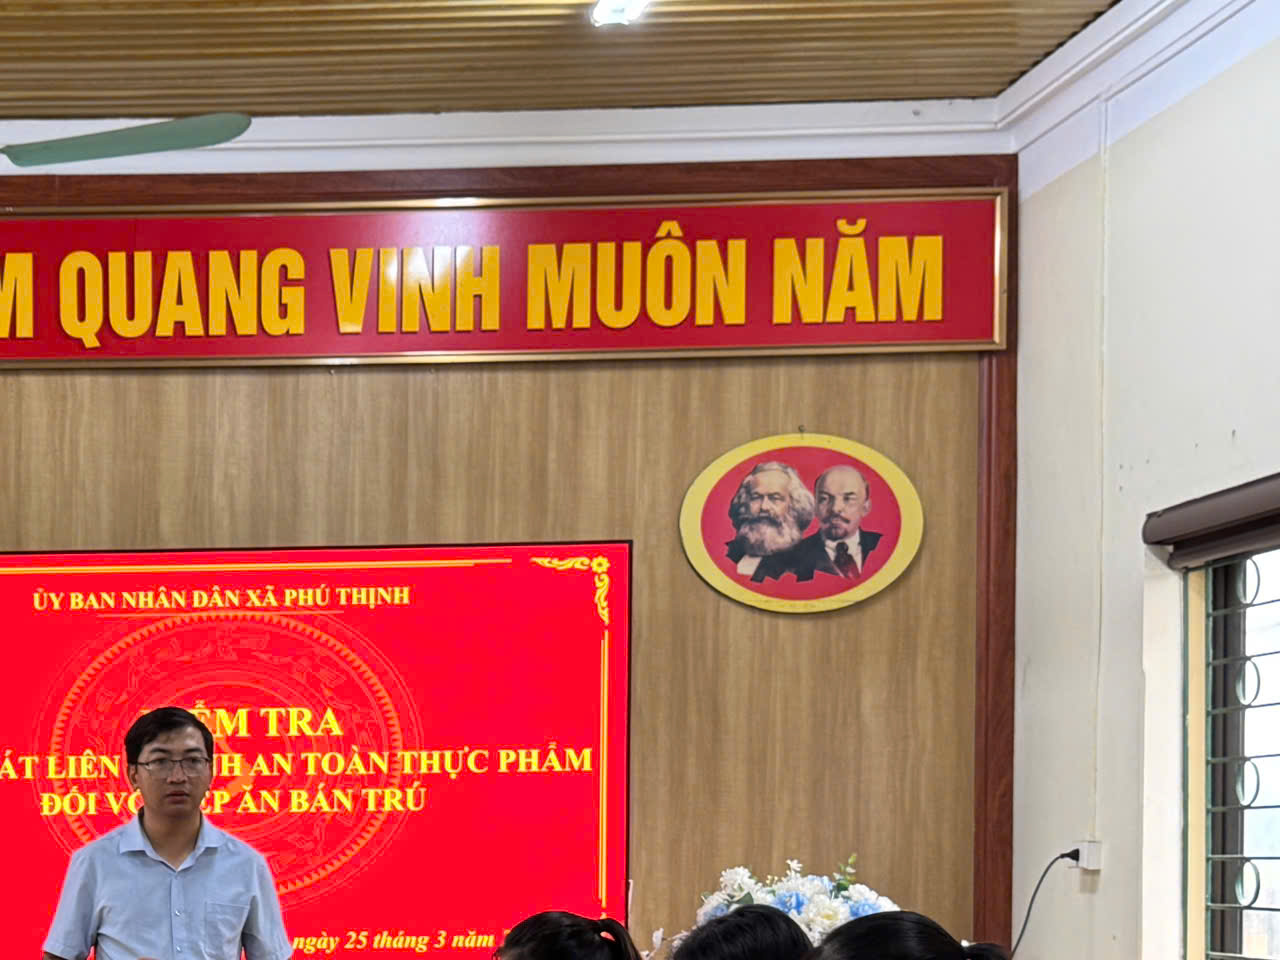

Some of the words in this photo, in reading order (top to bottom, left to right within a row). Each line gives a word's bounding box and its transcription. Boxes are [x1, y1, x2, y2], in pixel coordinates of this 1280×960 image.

[59, 247, 305, 348] QUANG
[329, 244, 501, 334] VINH
[527, 220, 746, 328] MUÔN
[772, 218, 943, 324] NĂM
[33, 587, 65, 610] ỦY
[70, 591, 115, 610] BAN
[122, 587, 186, 610] NHÂN
[193, 585, 239, 608] DÂN
[246, 585, 278, 607] XÃ
[284, 582, 329, 606] PHÚ
[336, 586, 410, 609] THỊNH
[260, 706, 344, 737] TRA
[46, 748, 121, 780] LIÊN
[248, 752, 293, 777] AN
[300, 745, 389, 777] TOÀN
[394, 744, 489, 780] THỰC
[498, 741, 593, 773] PHẨM
[39, 784, 98, 816] ĐỐI
[235, 784, 281, 814] ĂN
[288, 783, 353, 813] BÁN
[361, 780, 427, 813] TRÚ
[292, 931, 340, 954] ngày
[344, 931, 369, 949] 25
[372, 930, 430, 953] tháng
[434, 930, 447, 948] 3
[451, 930, 496, 948] năm
